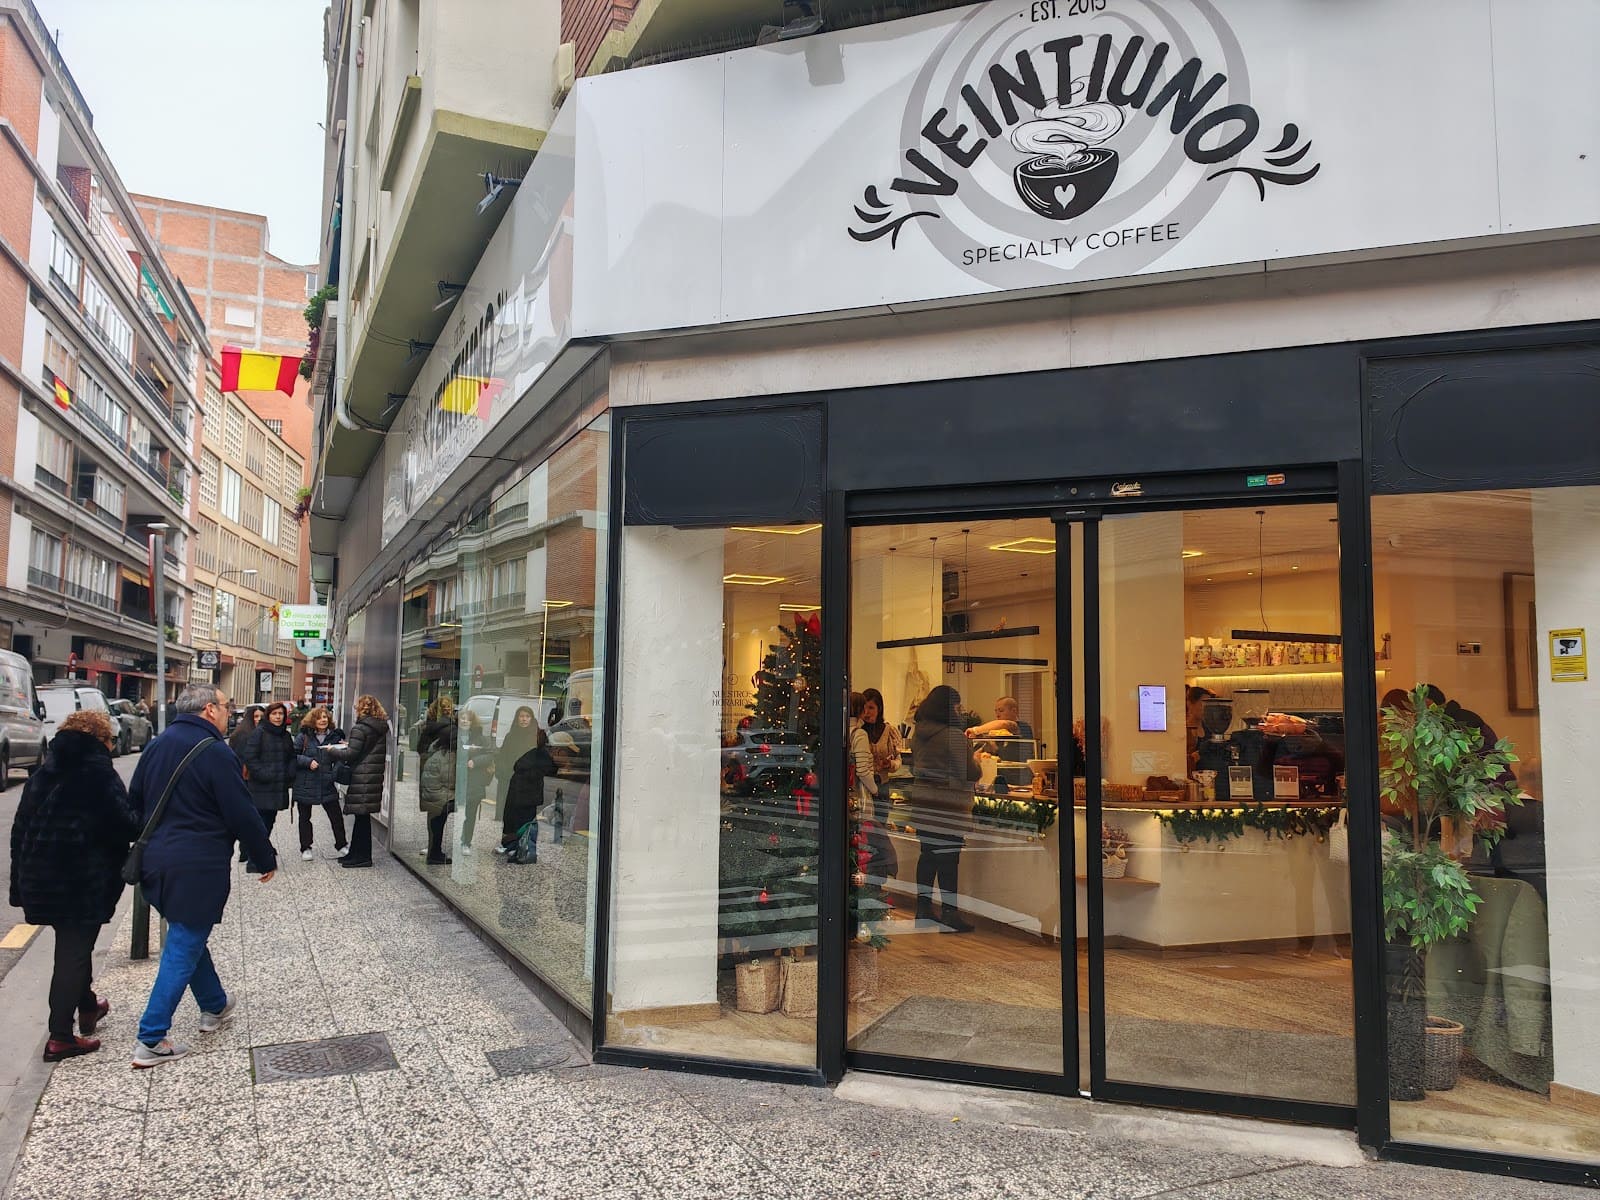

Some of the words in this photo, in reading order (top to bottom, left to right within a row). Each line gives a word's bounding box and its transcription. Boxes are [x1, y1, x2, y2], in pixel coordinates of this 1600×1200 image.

[1031, 0, 1061, 22] EST.
[889, 33, 1260, 196] VEINTIUNO
[962, 236, 1078, 266] SPECIALTY
[1086, 222, 1180, 250] COFFEE
[712, 690, 753, 698] NSTROS
